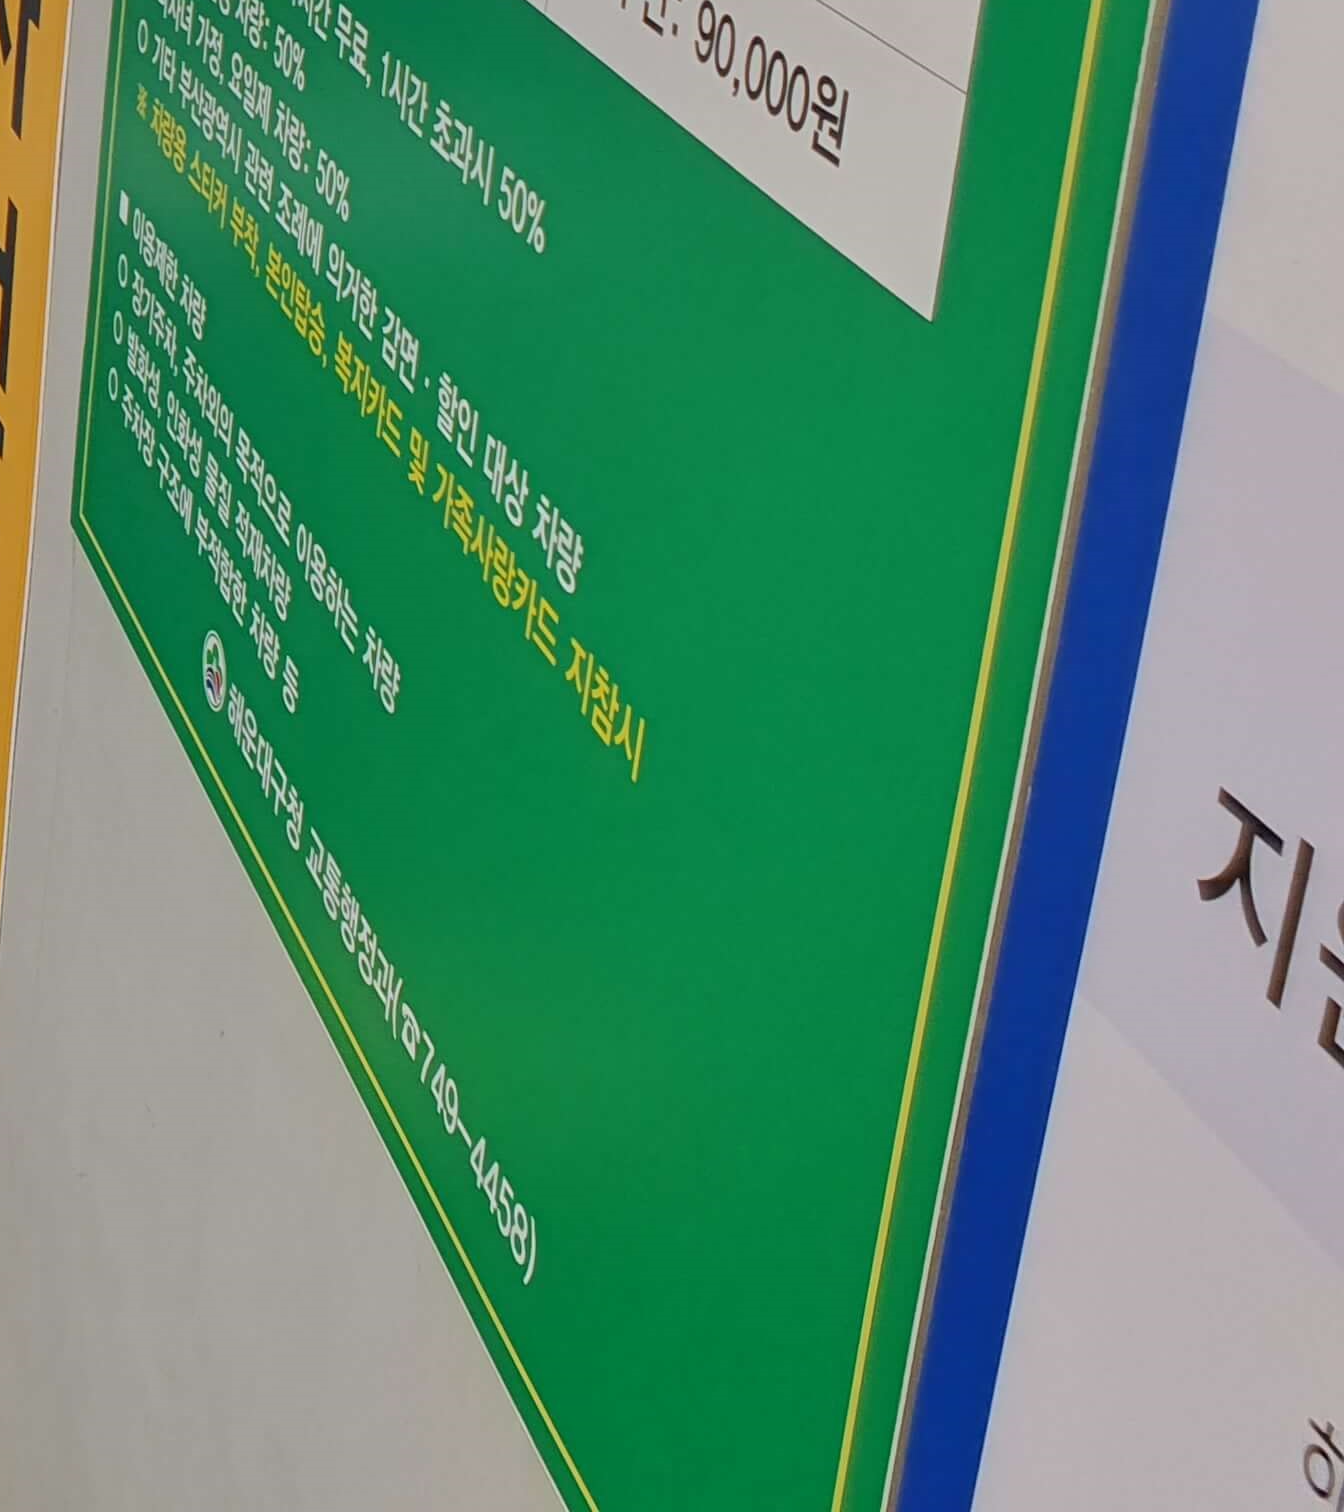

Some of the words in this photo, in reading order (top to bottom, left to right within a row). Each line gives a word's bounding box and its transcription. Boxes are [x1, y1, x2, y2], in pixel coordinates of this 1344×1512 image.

[195, 15, 224, 85] 가정,
[228, 52, 272, 136] 요일제
[273, 100, 312, 174] 차량:
[315, 149, 351, 223] 50%
[273, 25, 306, 91] 50%
[334, 3, 372, 88] 무료,
[381, 51, 429, 138] 1시간
[430, 99, 495, 206] 초과시
[497, 165, 547, 254] 50%
[132, 207, 179, 302] 이용제한
[179, 273, 207, 341] 차량
[151, 33, 177, 94] 기타
[178, 61, 242, 175] 부산광역시
[244, 140, 275, 213] 관련
[275, 181, 324, 277] 조례에
[326, 242, 378, 342] 의거한
[381, 305, 420, 394] 감면
[436, 370, 480, 469] 할인
[483, 432, 529, 528] 대상
[531, 493, 585, 595] 차량
[121, 384, 155, 468] 주차장
[157, 443, 194, 536] 구조에
[194, 507, 248, 628] 부적합한
[248, 600, 280, 680] 차량
[282, 655, 299, 714] 등
[131, 268, 178, 377] 장기주차,
[182, 346, 234, 458] 주차외의
[235, 427, 292, 548] 목적으로
[296, 523, 359, 655] 이용하는
[362, 625, 401, 714] 차량
[149, 97, 188, 175] 차량용
[188, 150, 228, 230] 스티커
[229, 195, 261, 278] 부착,
[265, 241, 328, 369] 본인탑승,
[334, 330, 404, 459] 복지카드
[407, 425, 430, 496] 및
[432, 462, 560, 668] 가족사랑카드
[564, 635, 647, 785] 지참시
[166, 390, 202, 478] 인화성
[204, 451, 232, 529] 물질
[235, 500, 292, 622] 적재차량
[227, 684, 305, 851] 해운대구청
[1196, 786, 1344, 1070] 지
